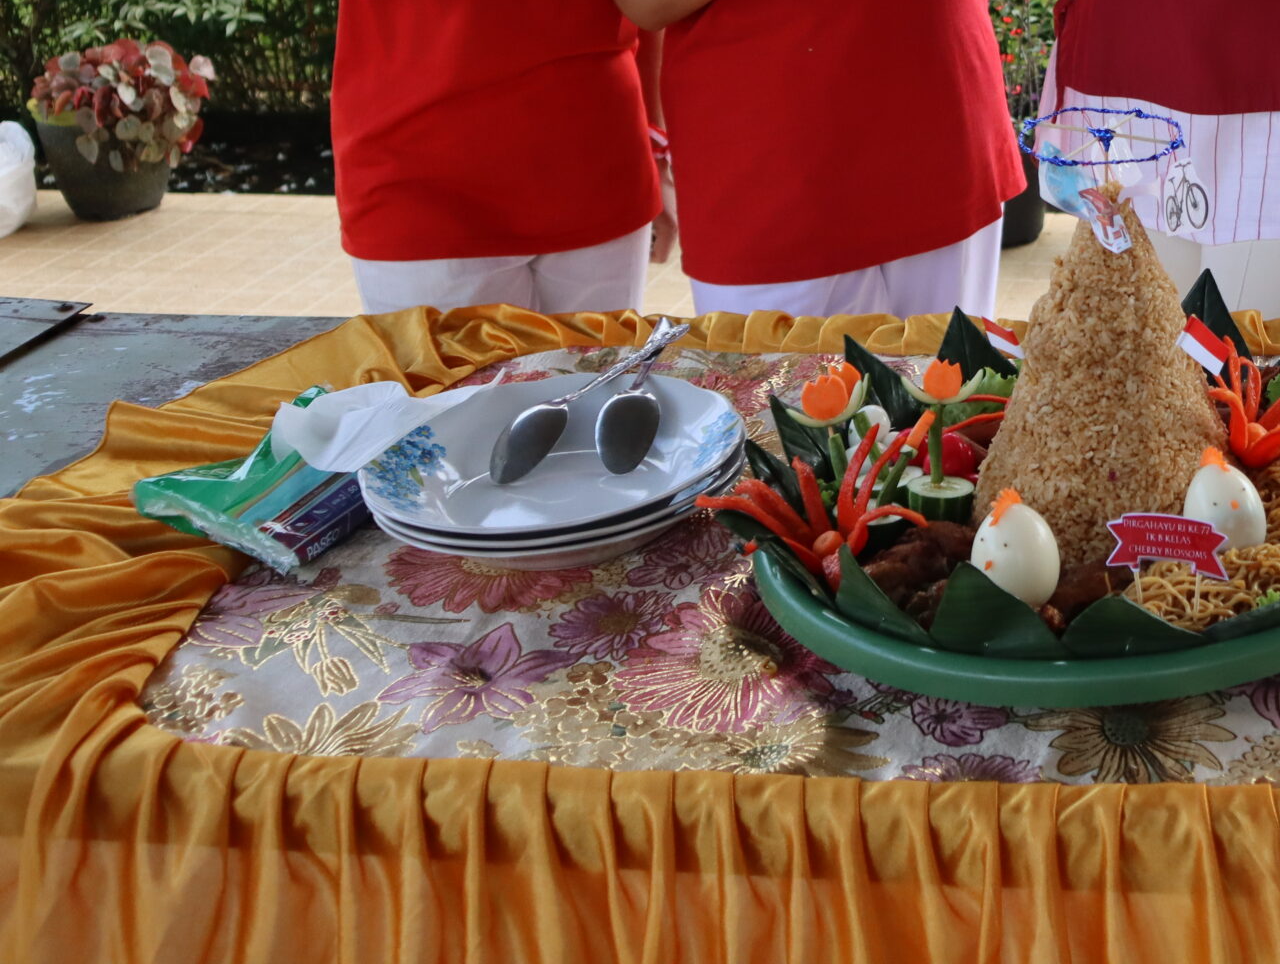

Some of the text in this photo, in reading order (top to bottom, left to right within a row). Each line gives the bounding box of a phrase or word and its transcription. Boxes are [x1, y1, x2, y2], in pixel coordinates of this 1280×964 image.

[1123, 519, 1175, 531] DIRGAHAYU
[1178, 523, 1186, 532] RI
[1201, 525, 1210, 535] 77
[1165, 533, 1191, 545] KELAS
[1128, 544, 1207, 559] CHERRY BLOSSOMS
